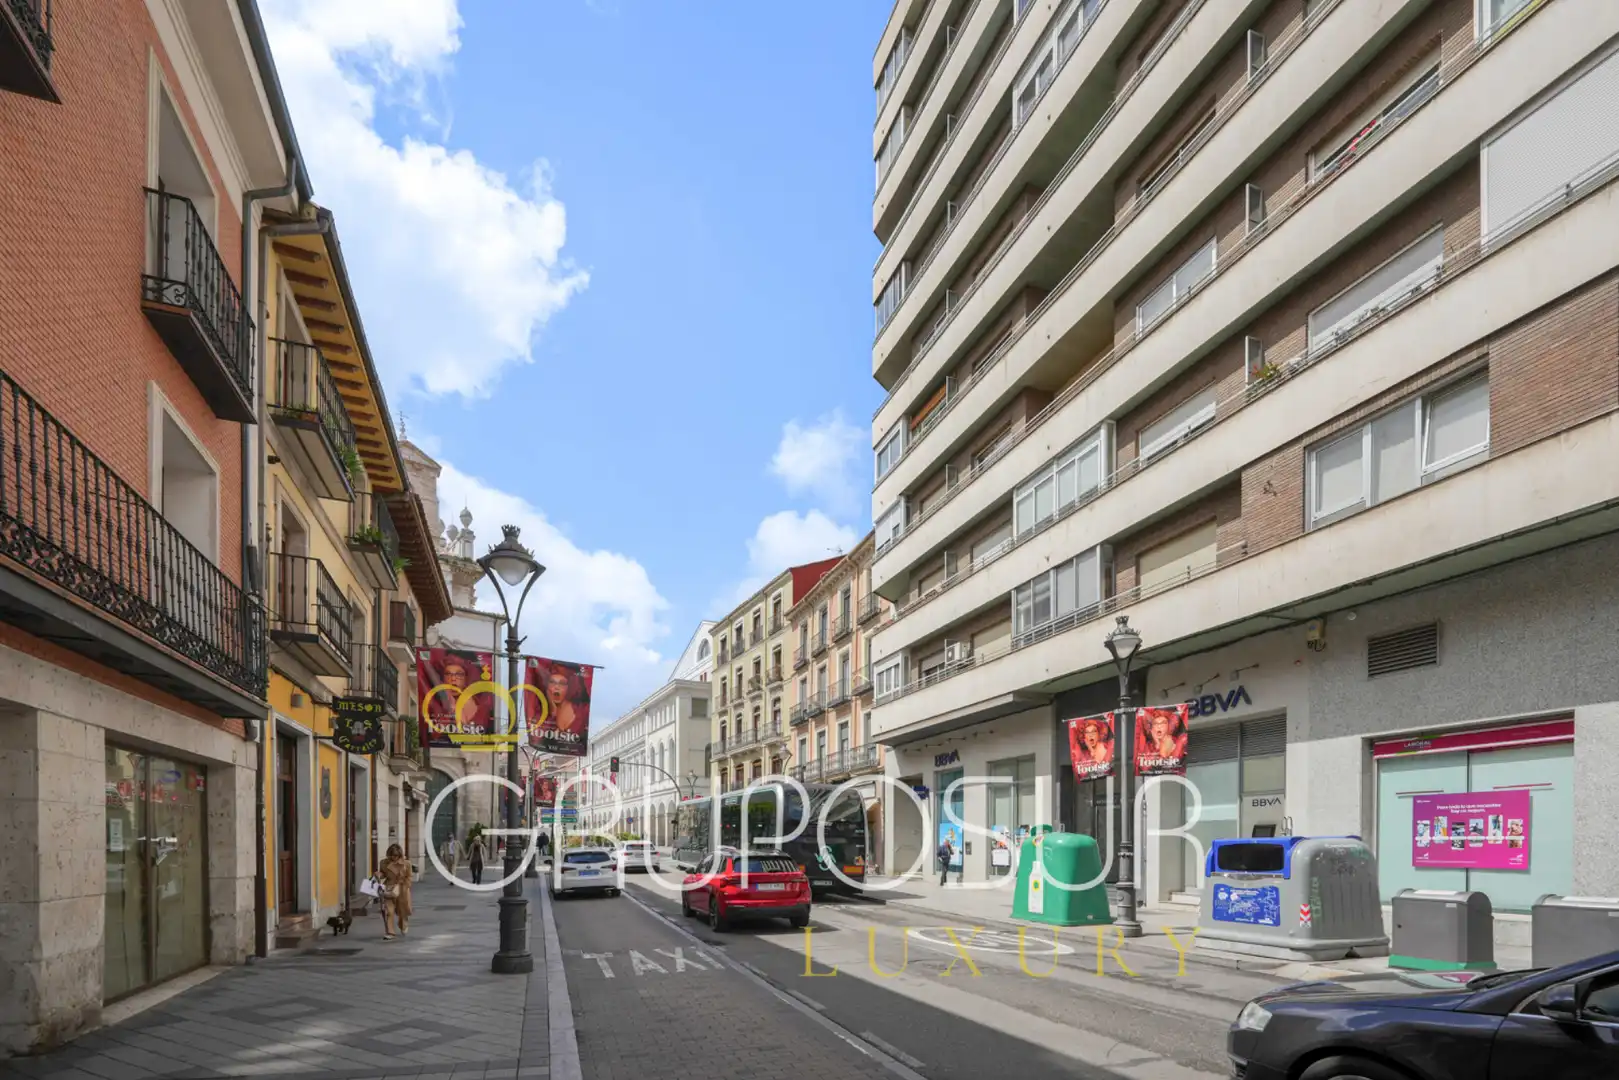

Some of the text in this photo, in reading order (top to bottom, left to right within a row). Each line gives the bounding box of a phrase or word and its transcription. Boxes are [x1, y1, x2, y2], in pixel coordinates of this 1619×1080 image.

[1184, 685, 1252, 718] BBVA
[1076, 761, 1110, 774] Tootsie
[1138, 755, 1180, 767] Tootsie
[1252, 797, 1281, 807] BBVA
[581, 948, 725, 978] TAXI
